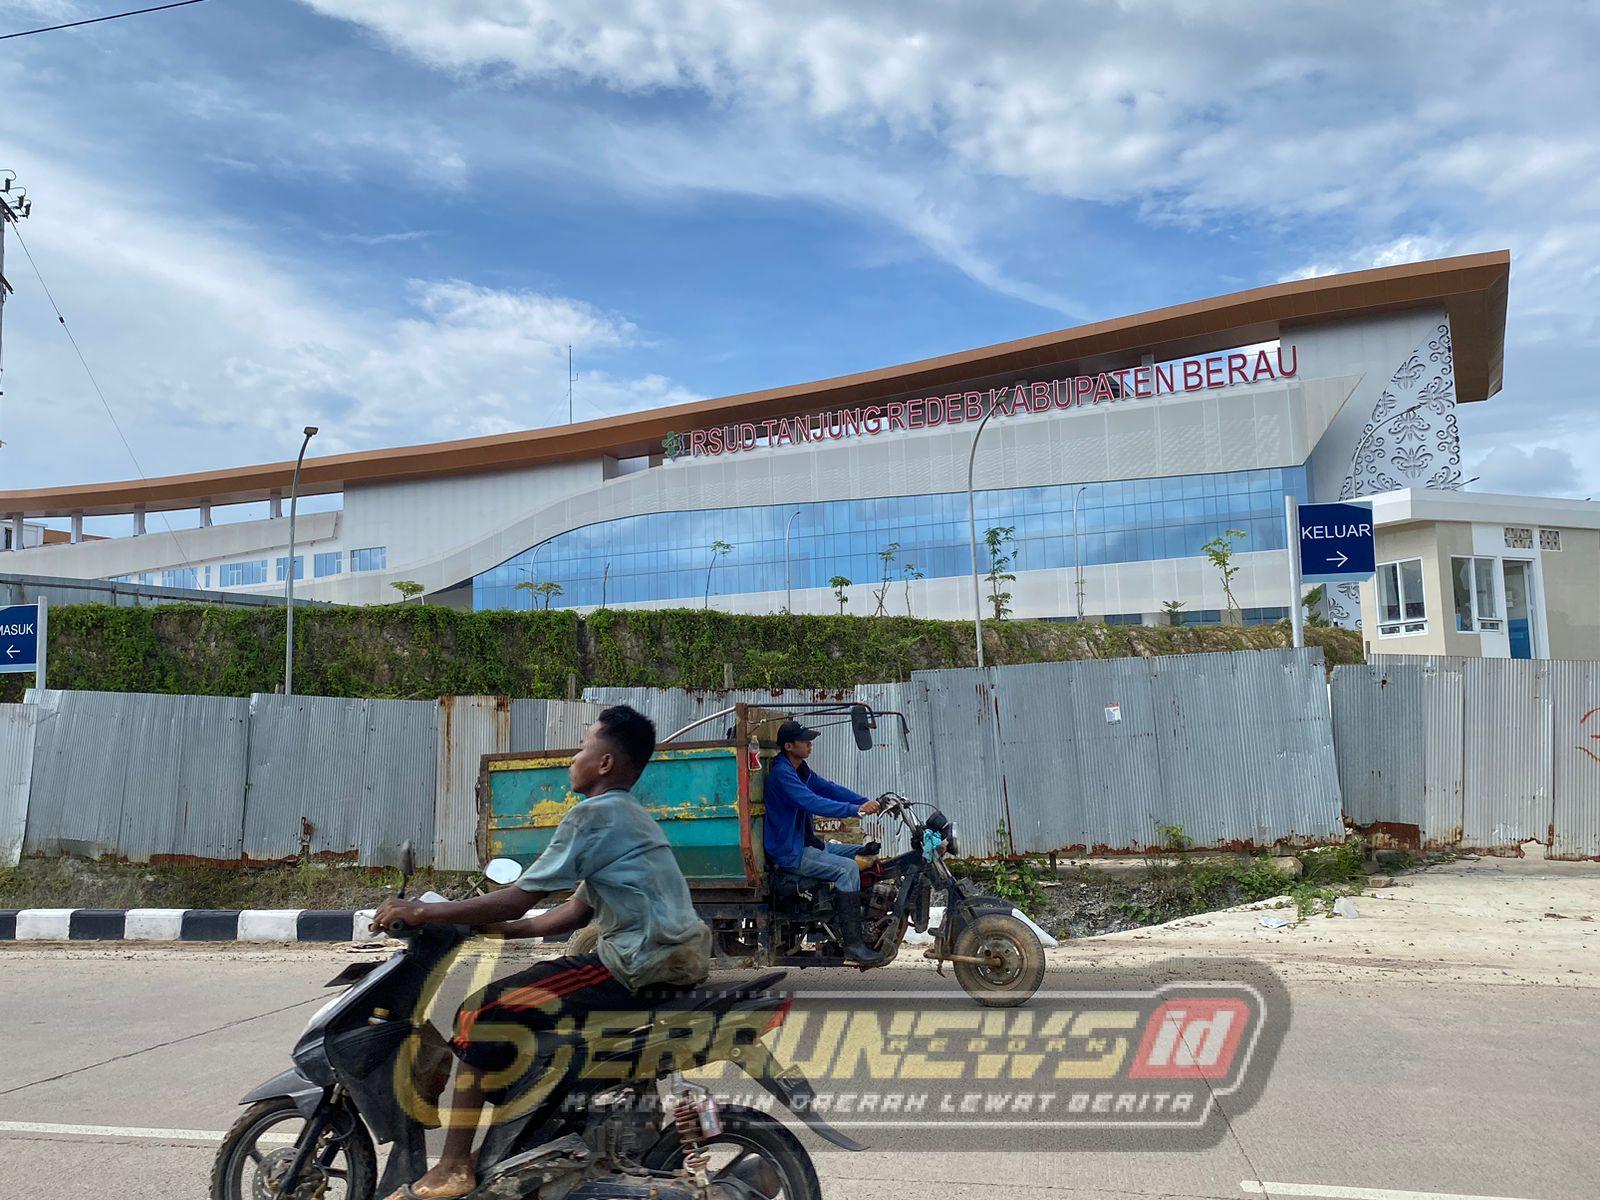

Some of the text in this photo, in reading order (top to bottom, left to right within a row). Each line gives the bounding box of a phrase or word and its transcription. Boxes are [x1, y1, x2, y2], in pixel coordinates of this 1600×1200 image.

[690, 345, 1298, 458] RSUD TANJUNG REDEB KABUPATEN BERAU
[1301, 523, 1371, 540] KELUAR
